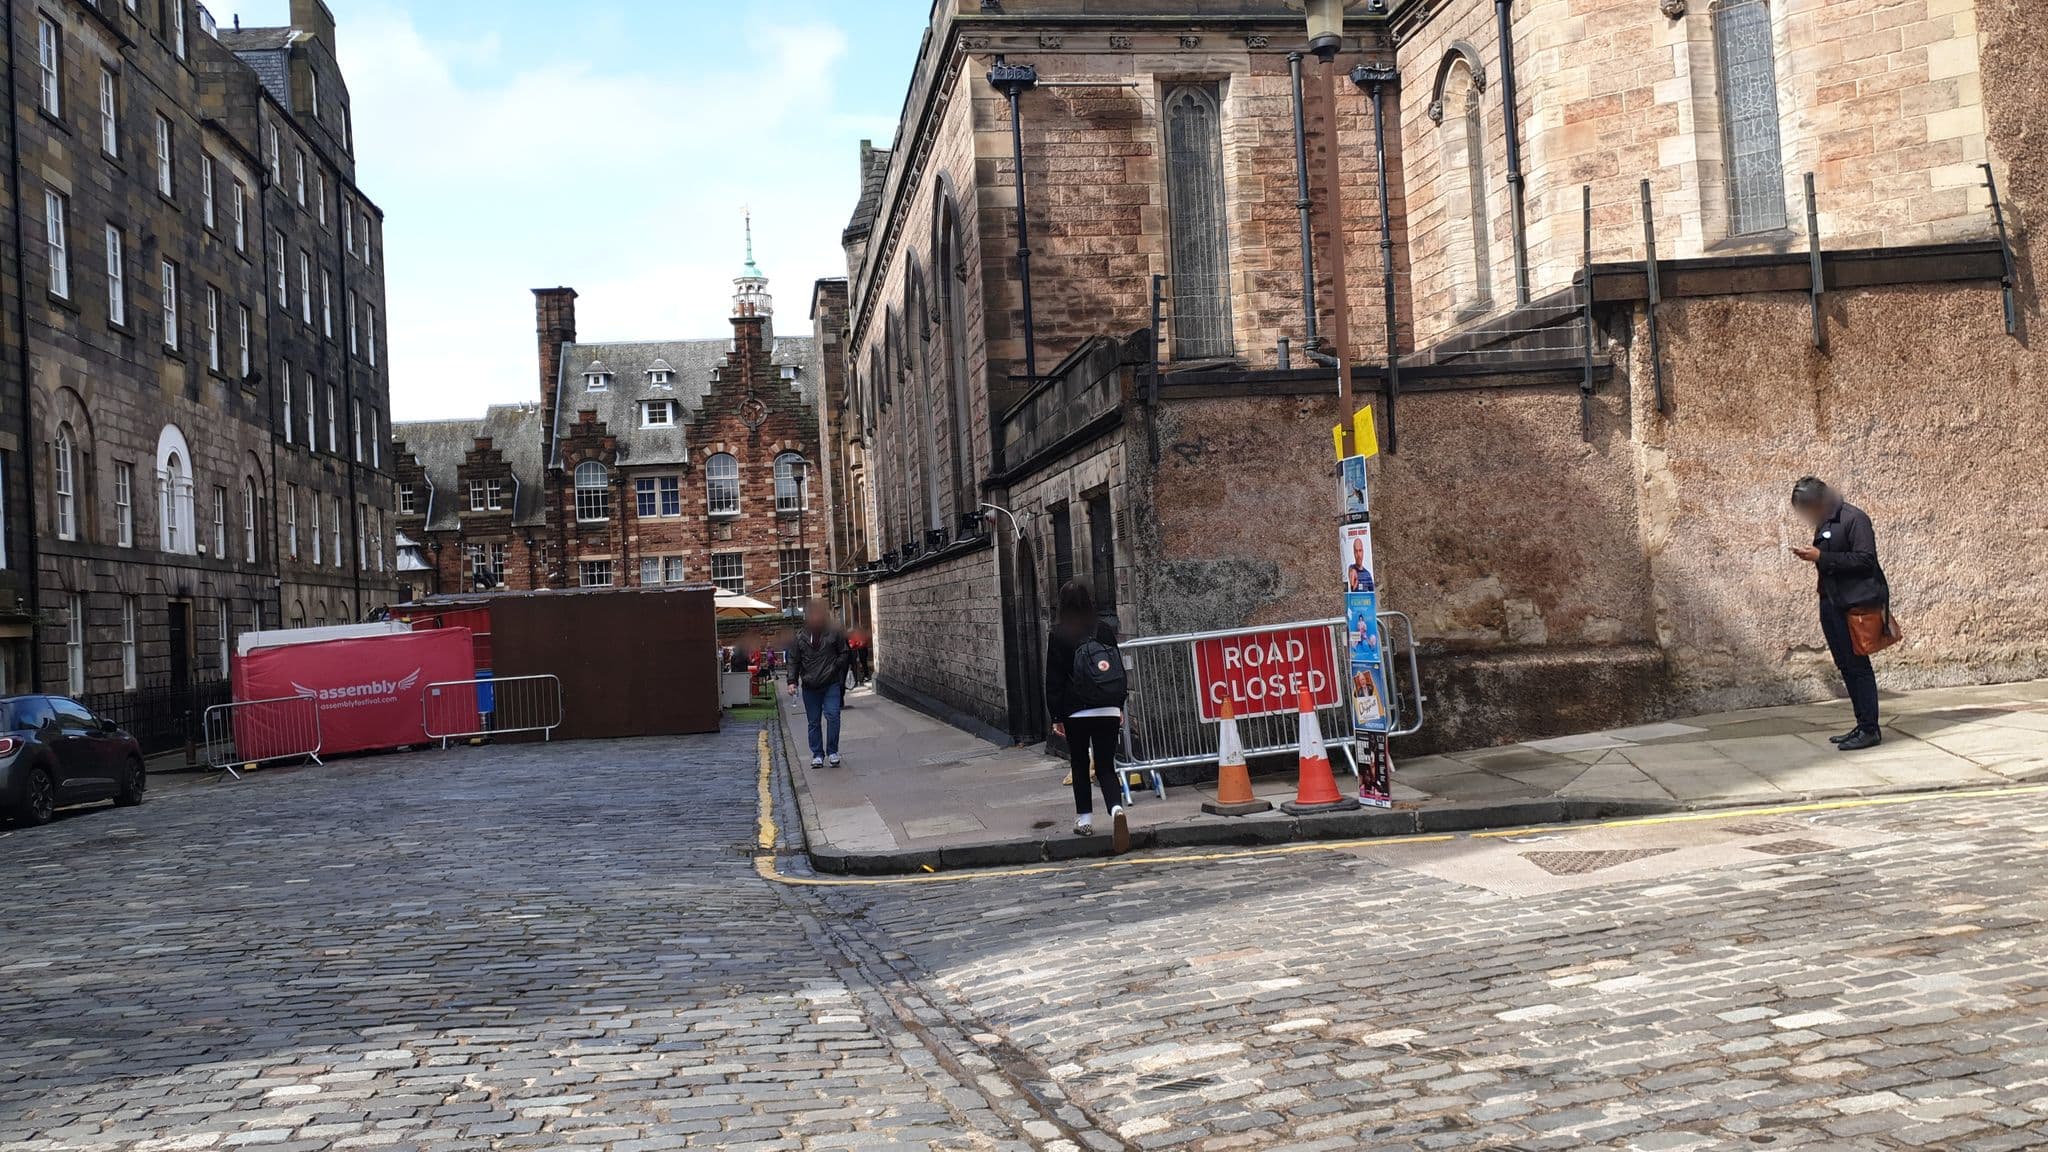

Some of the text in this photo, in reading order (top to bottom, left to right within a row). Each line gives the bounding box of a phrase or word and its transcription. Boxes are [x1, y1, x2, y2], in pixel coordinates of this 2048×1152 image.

[1224, 640, 1304, 669] ROAD
[319, 680, 397, 700] assembly
[1210, 670, 1326, 704] CLOSED
[320, 695, 398, 710] assemblyfestival.com
